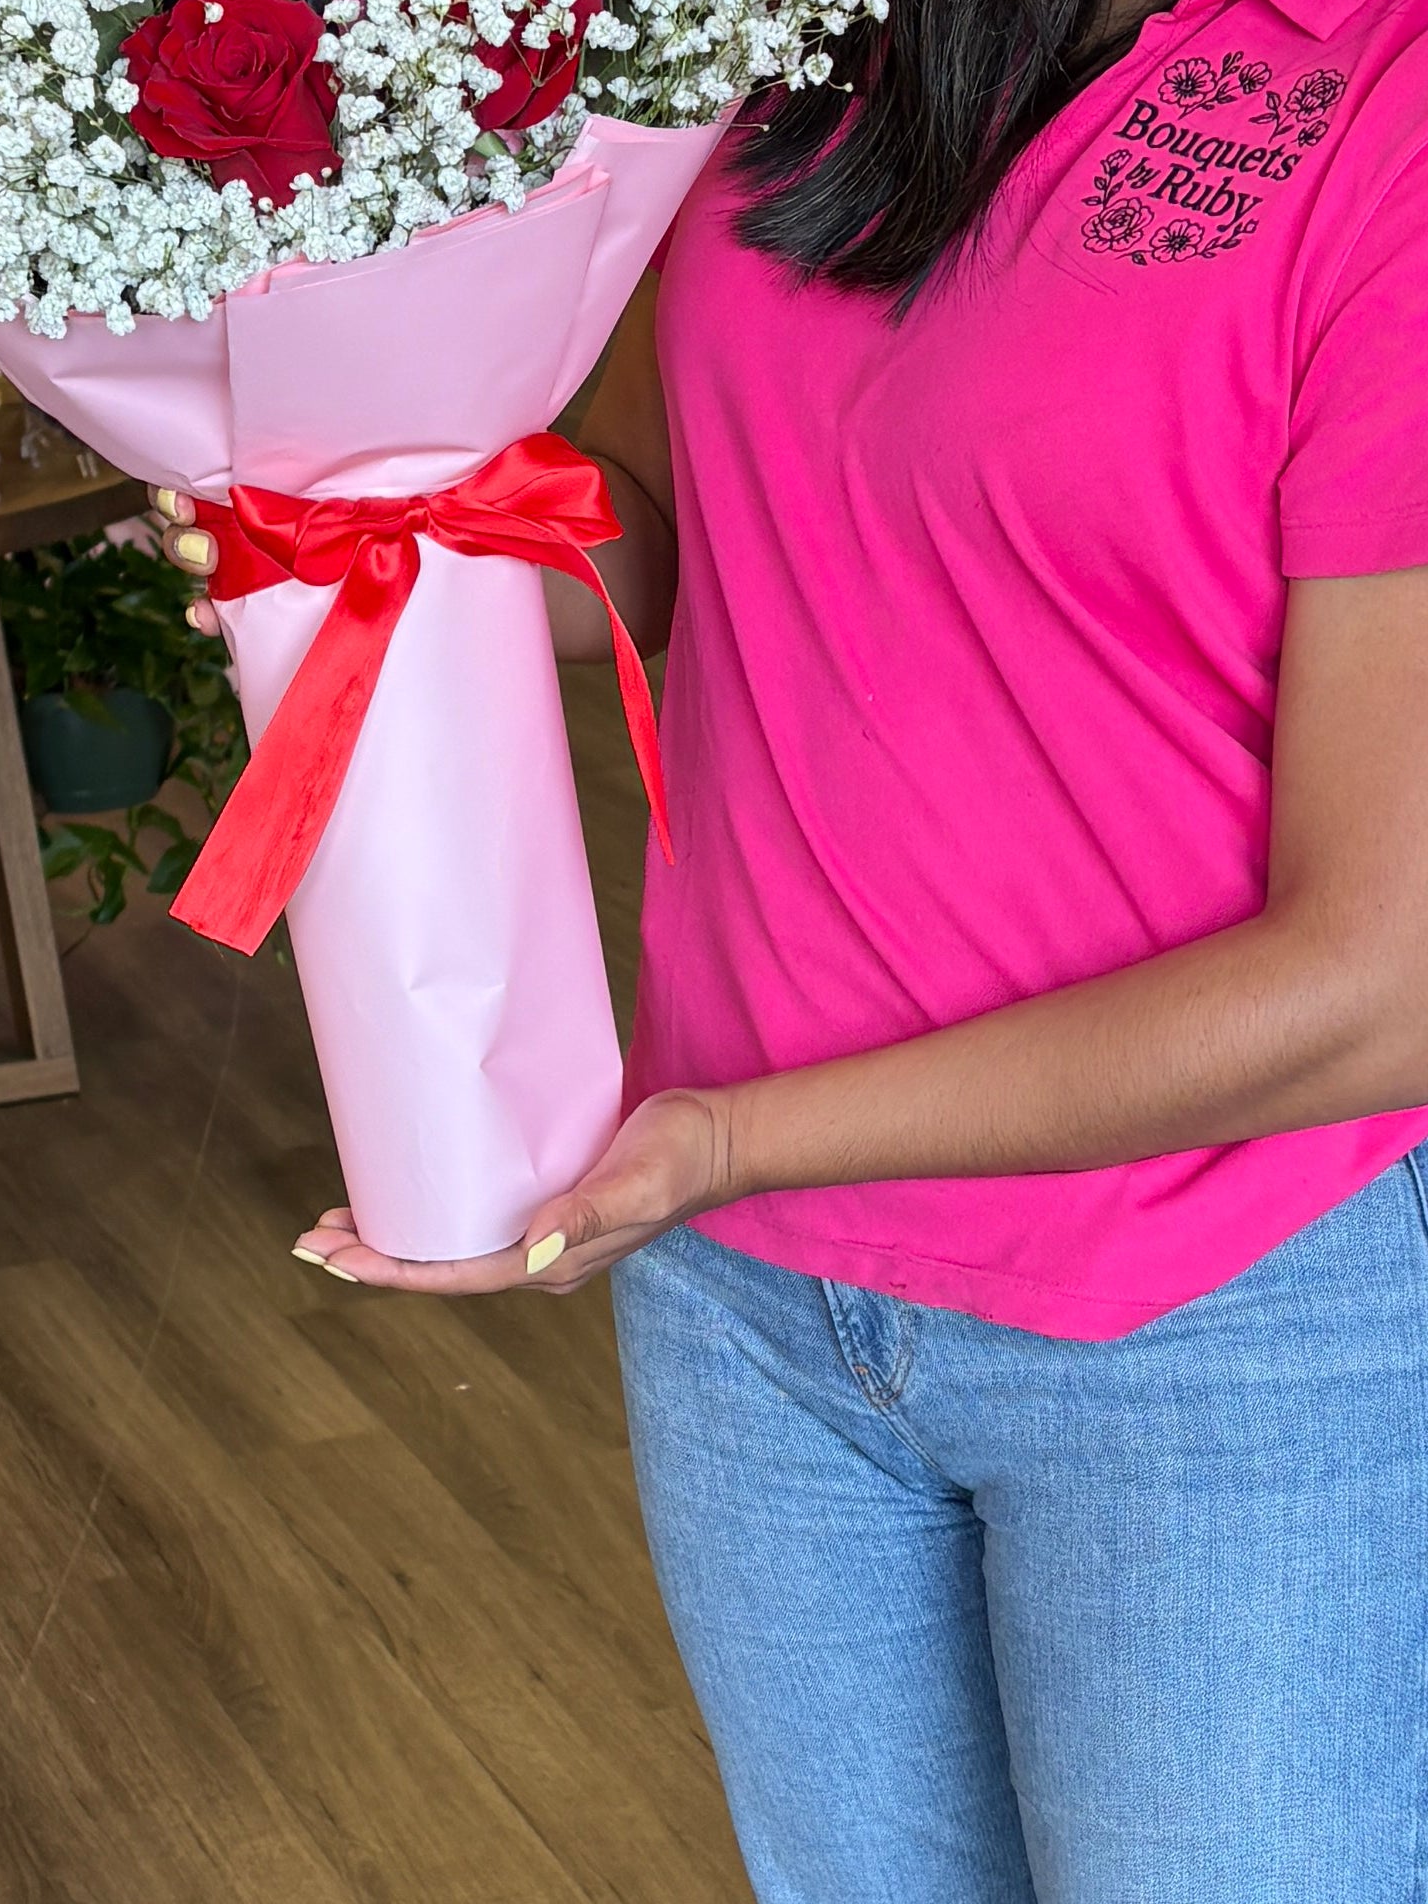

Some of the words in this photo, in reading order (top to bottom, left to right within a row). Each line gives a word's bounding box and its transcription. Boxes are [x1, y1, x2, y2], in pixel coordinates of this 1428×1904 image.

[1113, 98, 1302, 181] Bouquets
[1125, 157, 1161, 189] by
[1147, 162, 1263, 232] Ruby
